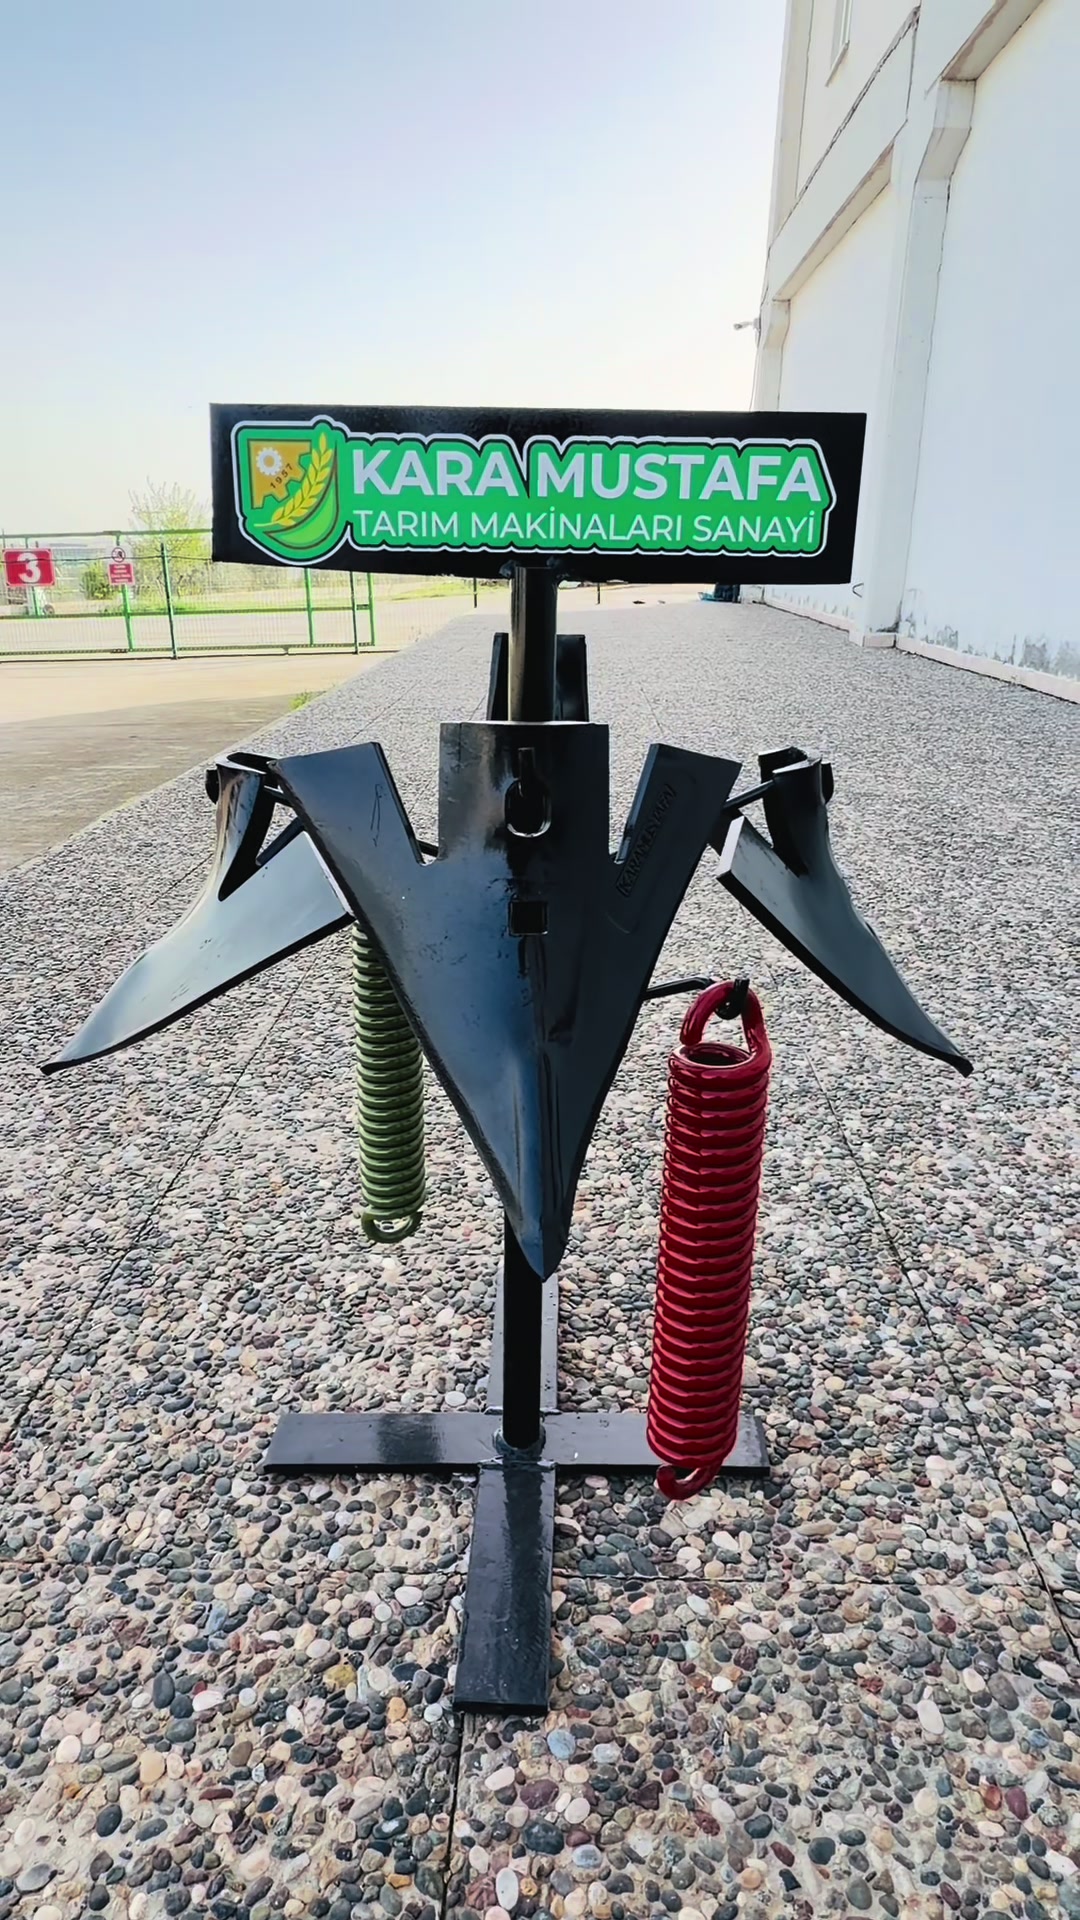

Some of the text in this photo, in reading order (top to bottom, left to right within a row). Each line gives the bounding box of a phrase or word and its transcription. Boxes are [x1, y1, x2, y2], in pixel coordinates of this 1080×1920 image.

[270, 463, 293, 489] 1957
[353, 449, 822, 502] KARA MUSTAFA
[353, 506, 815, 543] TARIM MAKİNALARI SANAYİ
[17, 552, 41, 583] 3
